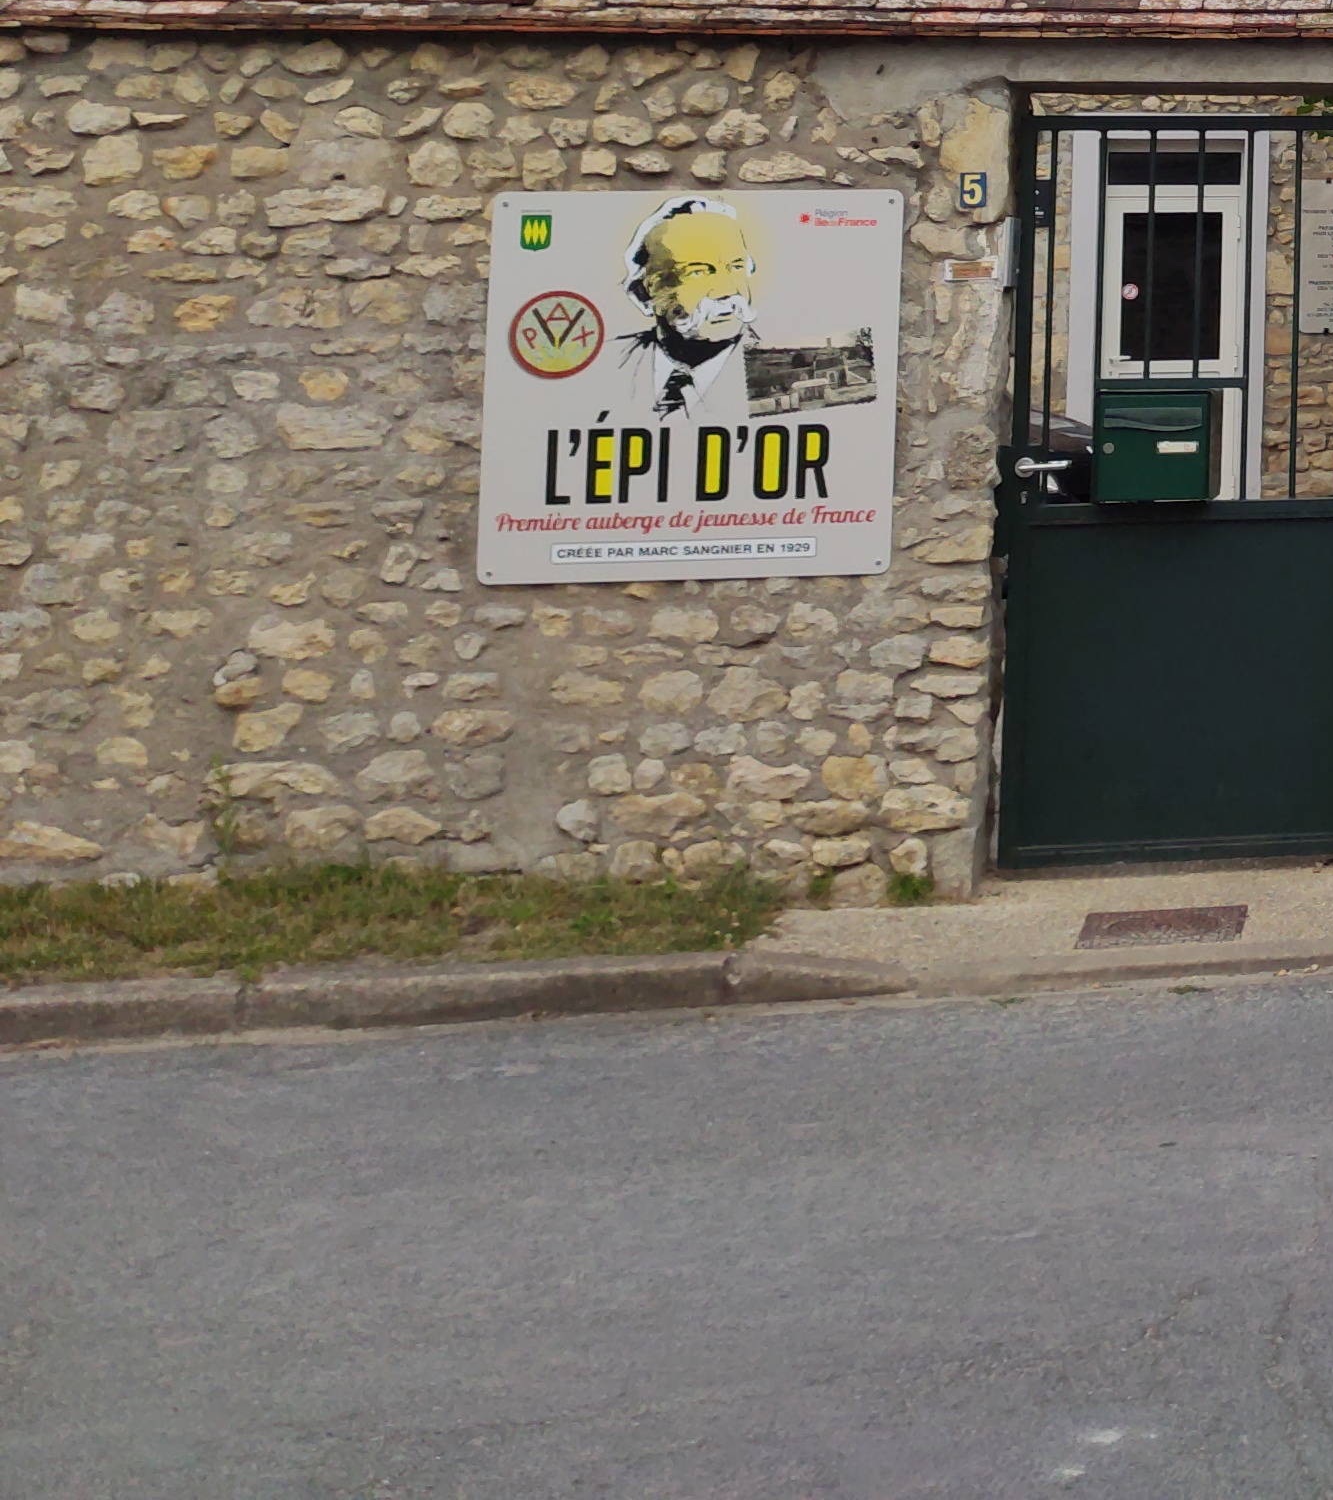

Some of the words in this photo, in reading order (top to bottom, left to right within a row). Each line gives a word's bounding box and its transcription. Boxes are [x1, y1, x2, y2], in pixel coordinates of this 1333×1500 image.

[962, 173, 982, 205] 5
[545, 410, 671, 505] L'ÉPI
[695, 424, 830, 502] D'OR
[496, 512, 581, 532] Première
[585, 512, 666, 534] auberge
[668, 510, 693, 529] de
[693, 509, 778, 533] jeunesse
[782, 508, 806, 525] de
[811, 505, 877, 524] France
[607, 546, 634, 558] PAR
[638, 545, 679, 557] MARC
[682, 543, 753, 556] SANGNIER
[757, 543, 775, 554] EN
[780, 542, 811, 553] 1929
